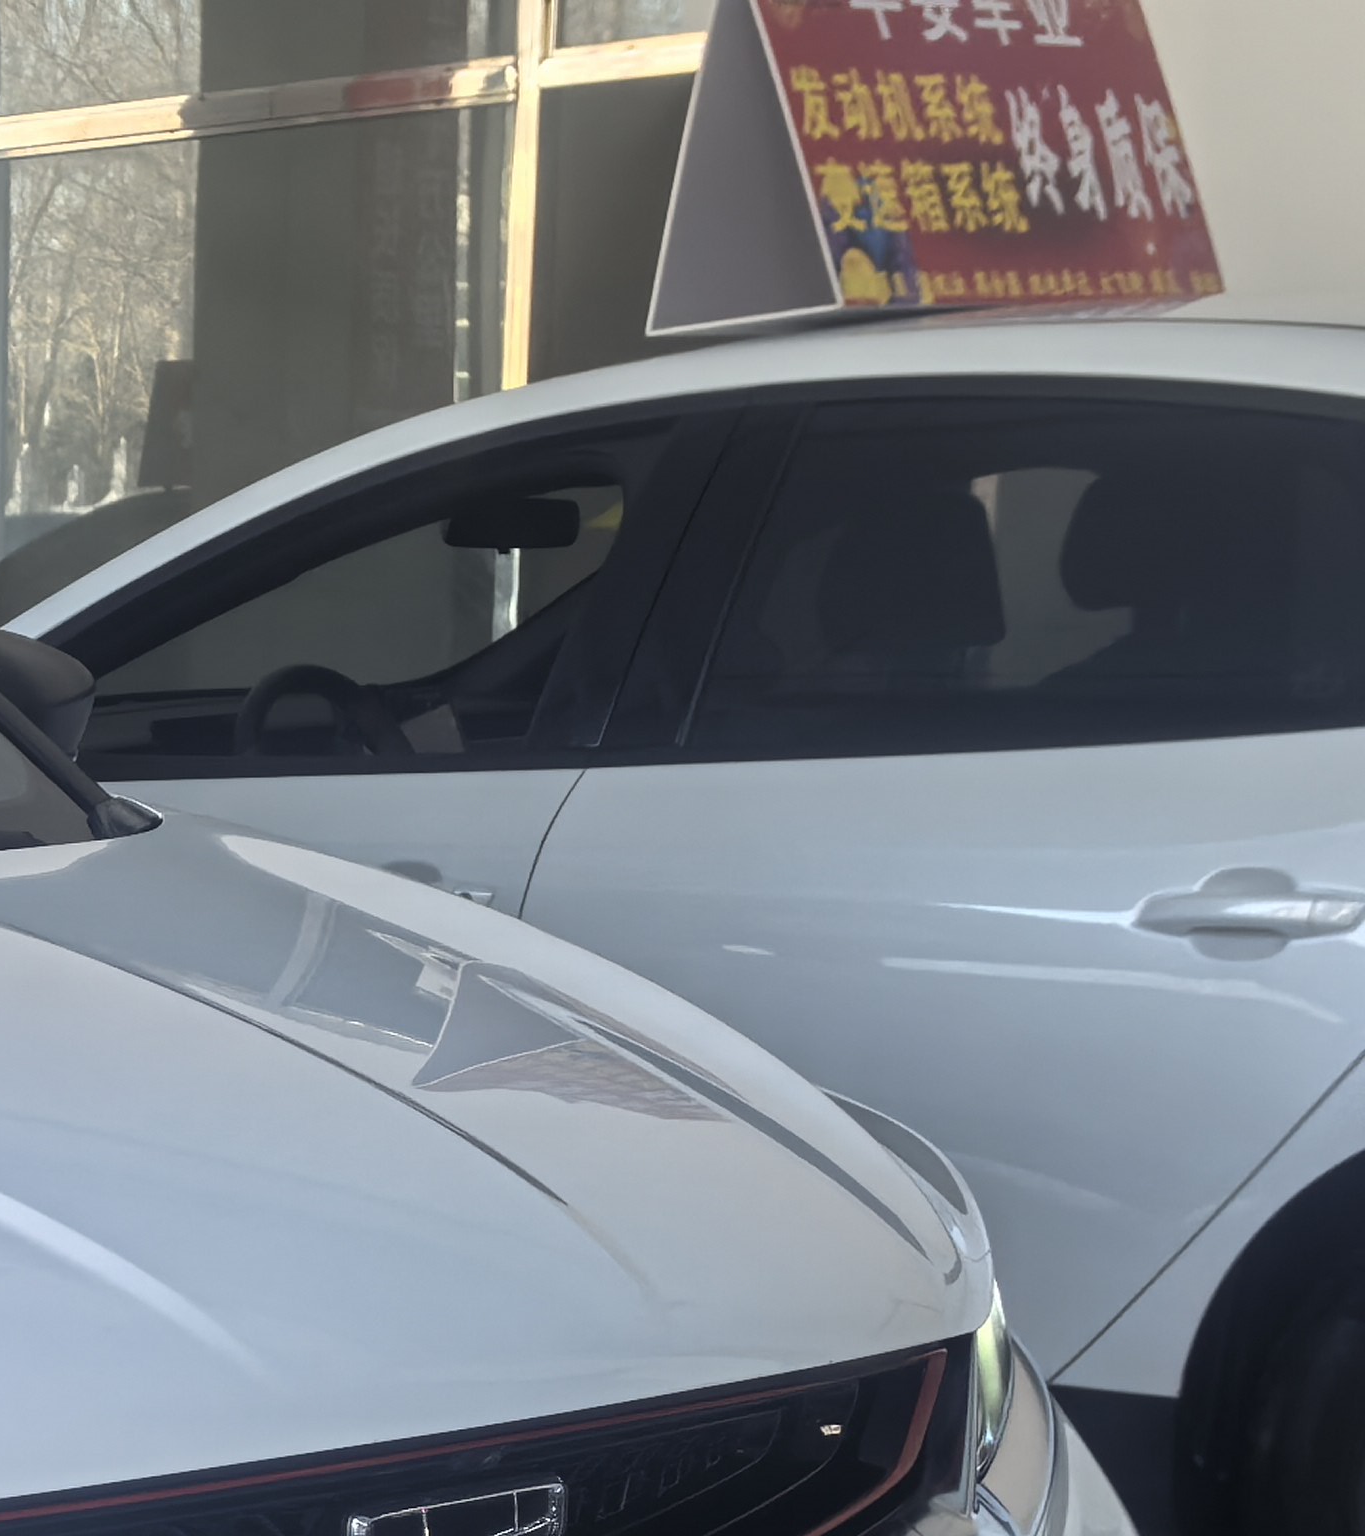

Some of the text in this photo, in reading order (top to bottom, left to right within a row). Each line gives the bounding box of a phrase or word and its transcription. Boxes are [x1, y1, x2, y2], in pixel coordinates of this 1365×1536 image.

[790, 65, 1004, 145] 发动机系统
[1004, 84, 1193, 222] 终身质保
